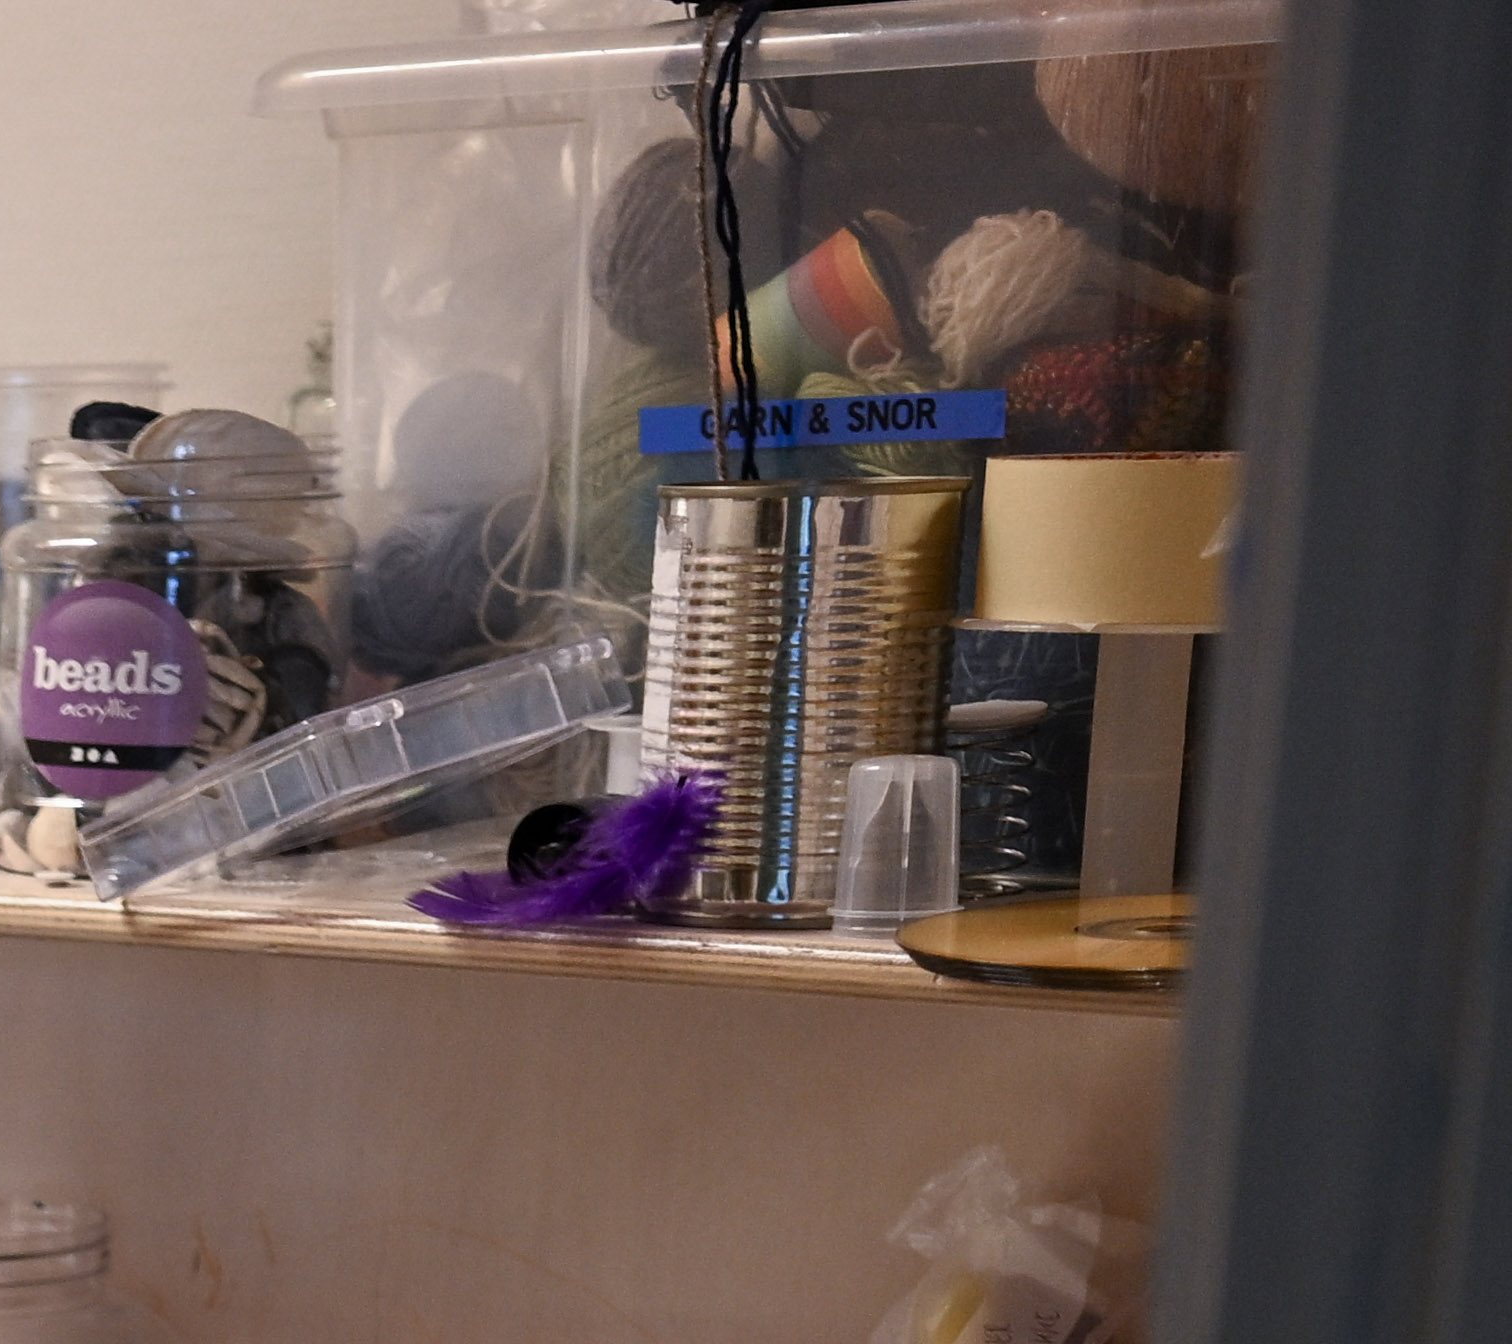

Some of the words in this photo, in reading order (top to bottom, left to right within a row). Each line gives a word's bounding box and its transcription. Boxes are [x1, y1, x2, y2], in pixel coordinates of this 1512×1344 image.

[808, 402, 831, 434] &
[848, 397, 938, 433] SNOR
[32, 645, 183, 696] beads
